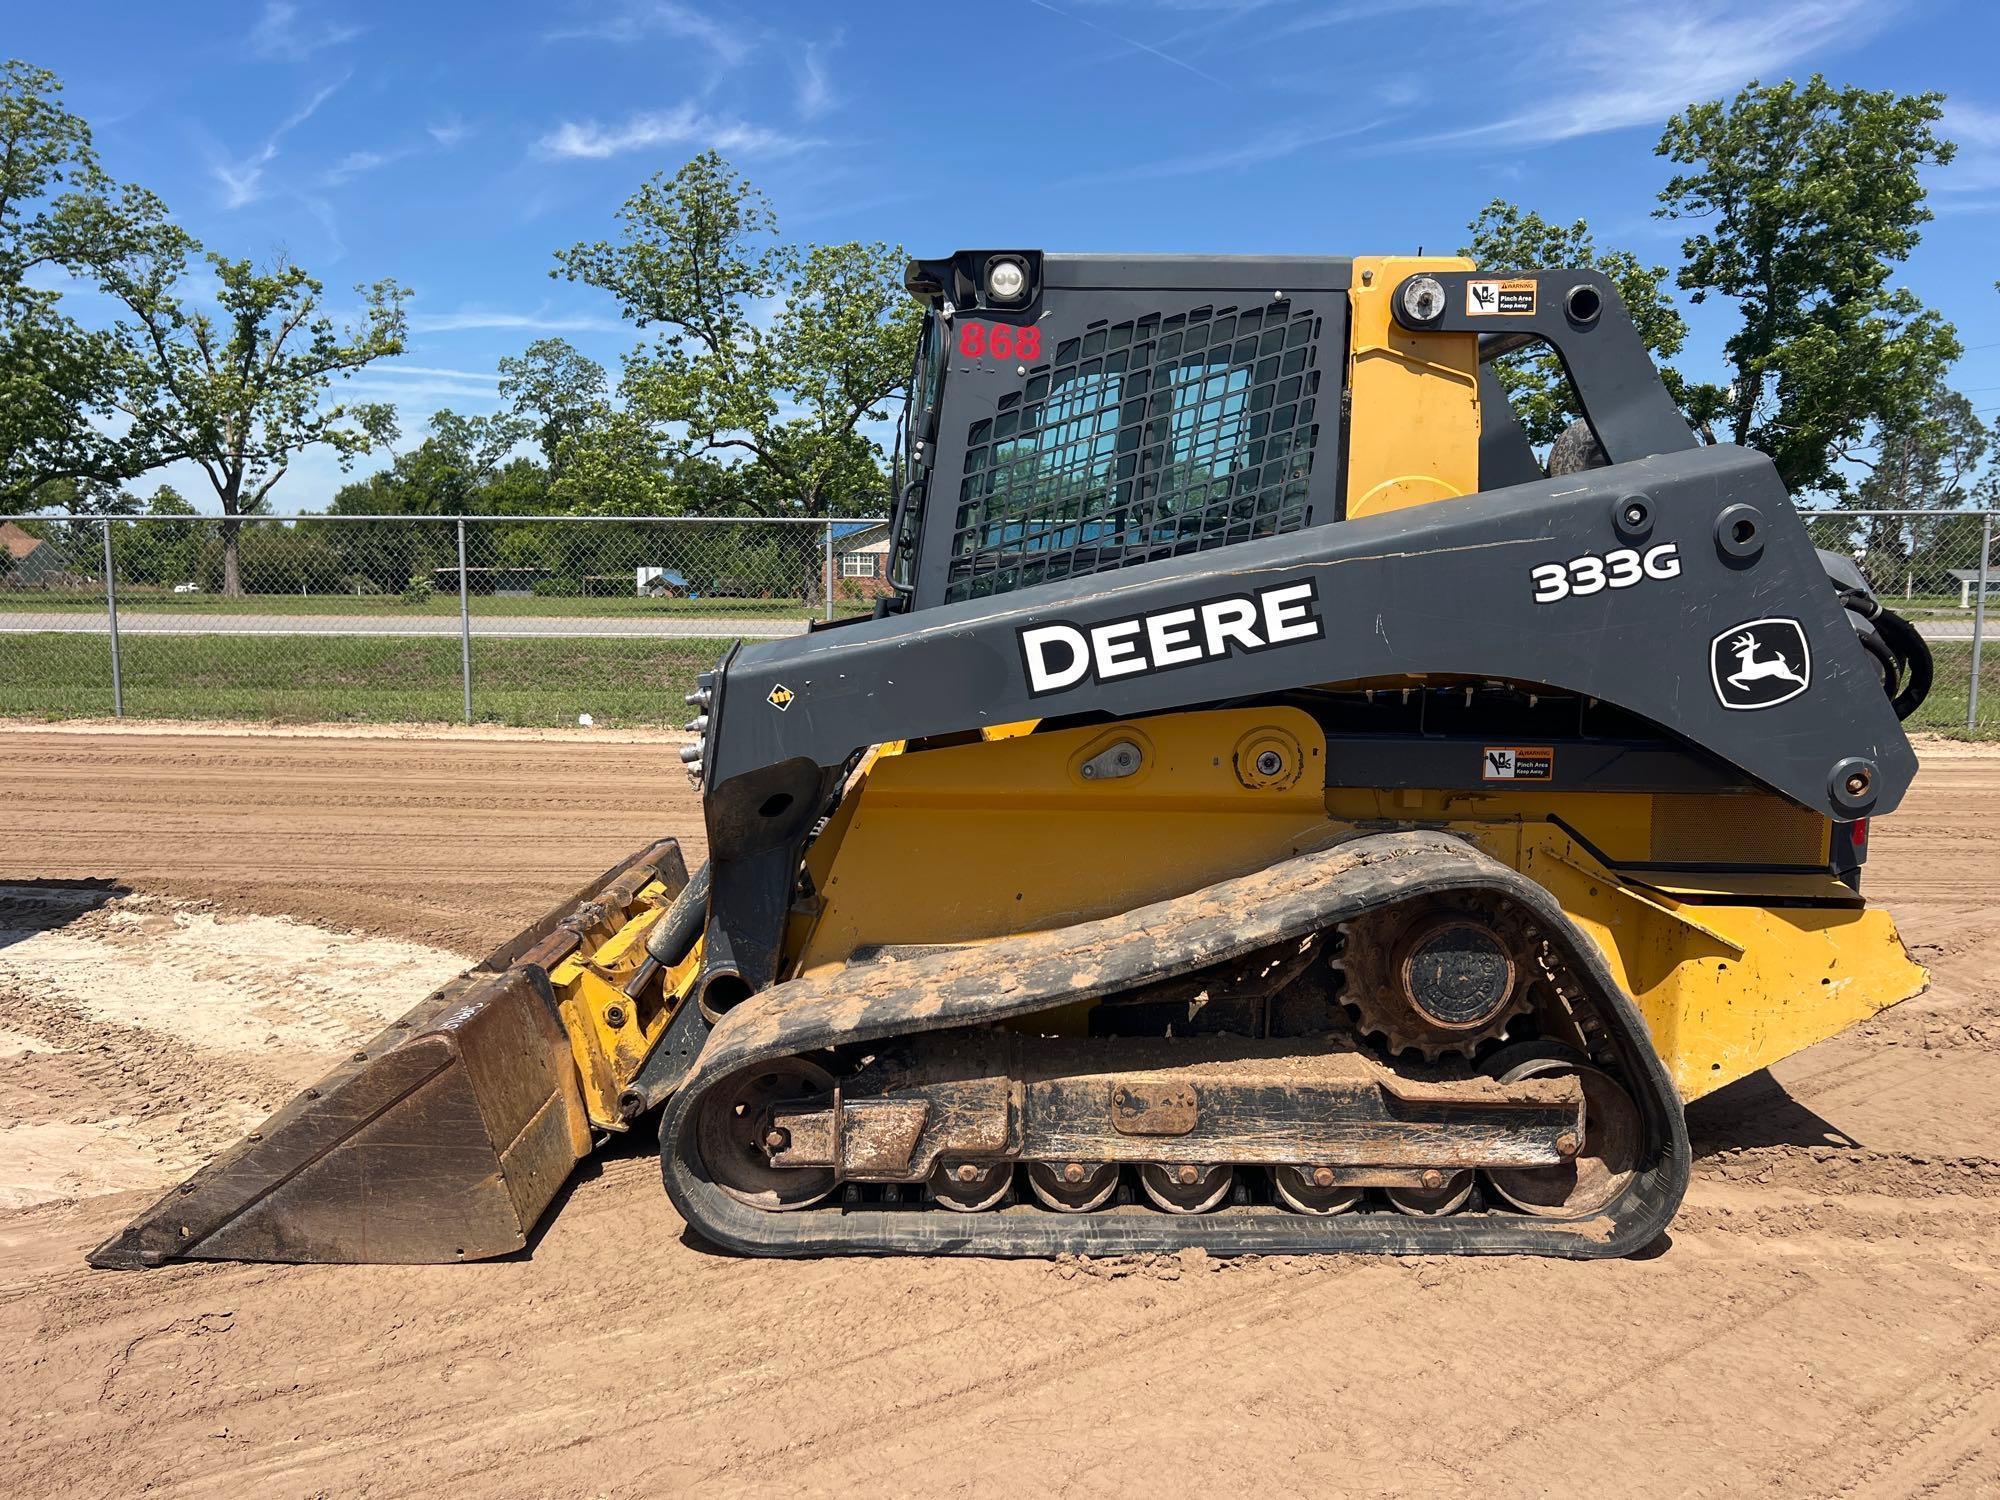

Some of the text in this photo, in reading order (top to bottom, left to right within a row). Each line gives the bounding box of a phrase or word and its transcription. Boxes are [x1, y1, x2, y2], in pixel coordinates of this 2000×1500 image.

[960, 322, 1040, 360] 868
[1531, 543, 1681, 603] 333G
[1022, 583, 1319, 692] DEERE
